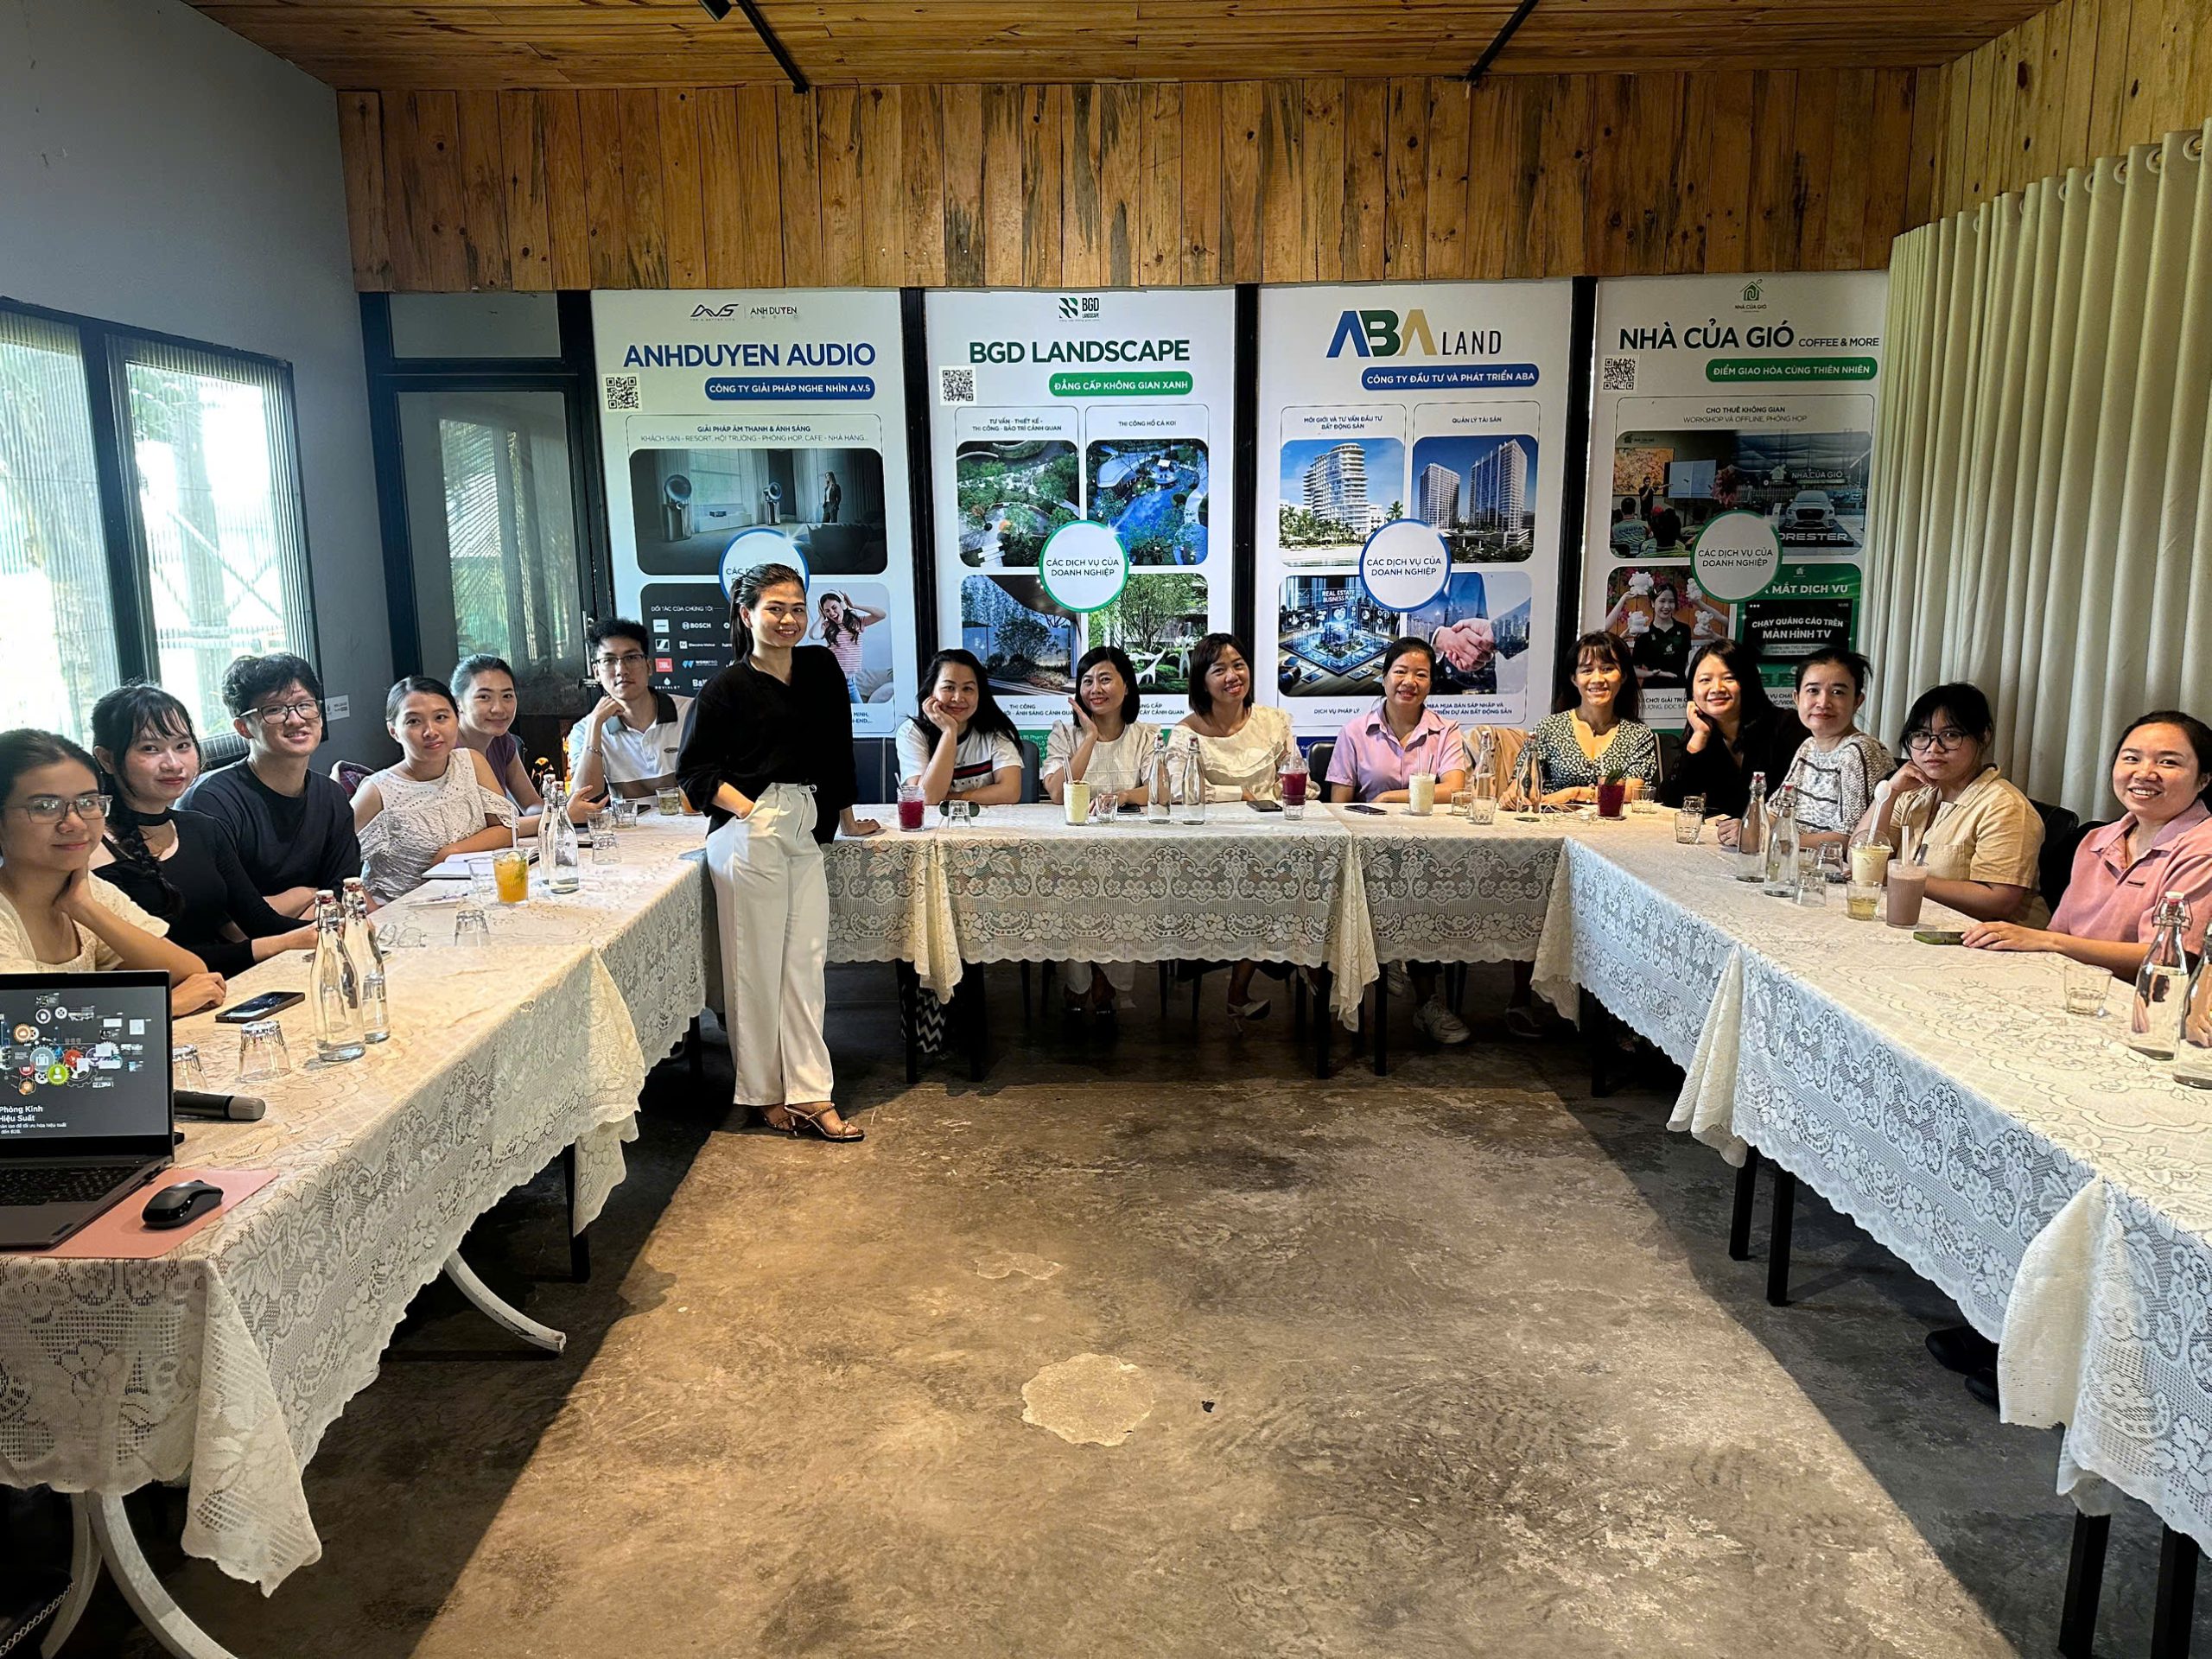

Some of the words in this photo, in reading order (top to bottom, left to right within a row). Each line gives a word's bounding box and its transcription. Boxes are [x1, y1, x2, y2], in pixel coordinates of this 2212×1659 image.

[1082, 298, 1099, 311] BGD
[1326, 309, 1438, 358] ABA
[1442, 331, 1502, 355] LAND
[1619, 321, 1677, 349] NHÀ
[1684, 318, 1739, 348] CỦA
[1746, 320, 1794, 348] GIÓ
[1840, 338, 1847, 346] &
[623, 344, 779, 367] ANHDUYEN
[786, 343, 875, 365] AUDIO
[969, 342, 1025, 364] BGD
[1033, 340, 1190, 363] LANDSCAPE
[1713, 364, 1736, 375] ĐIỂM
[1785, 365, 1810, 374] CÙNG
[1813, 365, 1839, 374] THIÊN
[1842, 365, 1870, 373] NHIÊN
[1367, 374, 1393, 384] CÔNG
[1410, 372, 1428, 383] ĐẦU
[1446, 373, 1459, 382] VÀ
[1461, 372, 1483, 381] PHÁT
[1487, 370, 1512, 381] TRIỂN
[709, 384, 735, 393] CÔNG
[752, 382, 770, 392] GIẢI
[772, 383, 797, 392] PHÁP
[826, 383, 848, 391] NHÌN
[1084, 380, 1101, 390] CẤP
[1103, 381, 1135, 390] KHÔNG
[791, 423, 810, 432] SÁNG
[1719, 550, 1738, 558] DỊCH
[1755, 547, 1773, 556] CỦA
[1102, 556, 1119, 566] CỦA
[1424, 556, 1441, 564] CỦA
[1736, 558, 1768, 567] NGHIỆP
[1084, 568, 1115, 577] NGHIỆP
[1405, 567, 1436, 575] NGHIỆP
[1772, 582, 1797, 594] MẮT
[1800, 585, 1828, 595] DỊCH
[1832, 585, 1848, 594] VỤ
[1752, 619, 1775, 628] CHẠY
[1776, 616, 1803, 625] QUẢNG
[1824, 618, 1843, 627] TRÊN
[1763, 628, 1788, 639] MÀN
[1789, 628, 1815, 639] HÌNH
